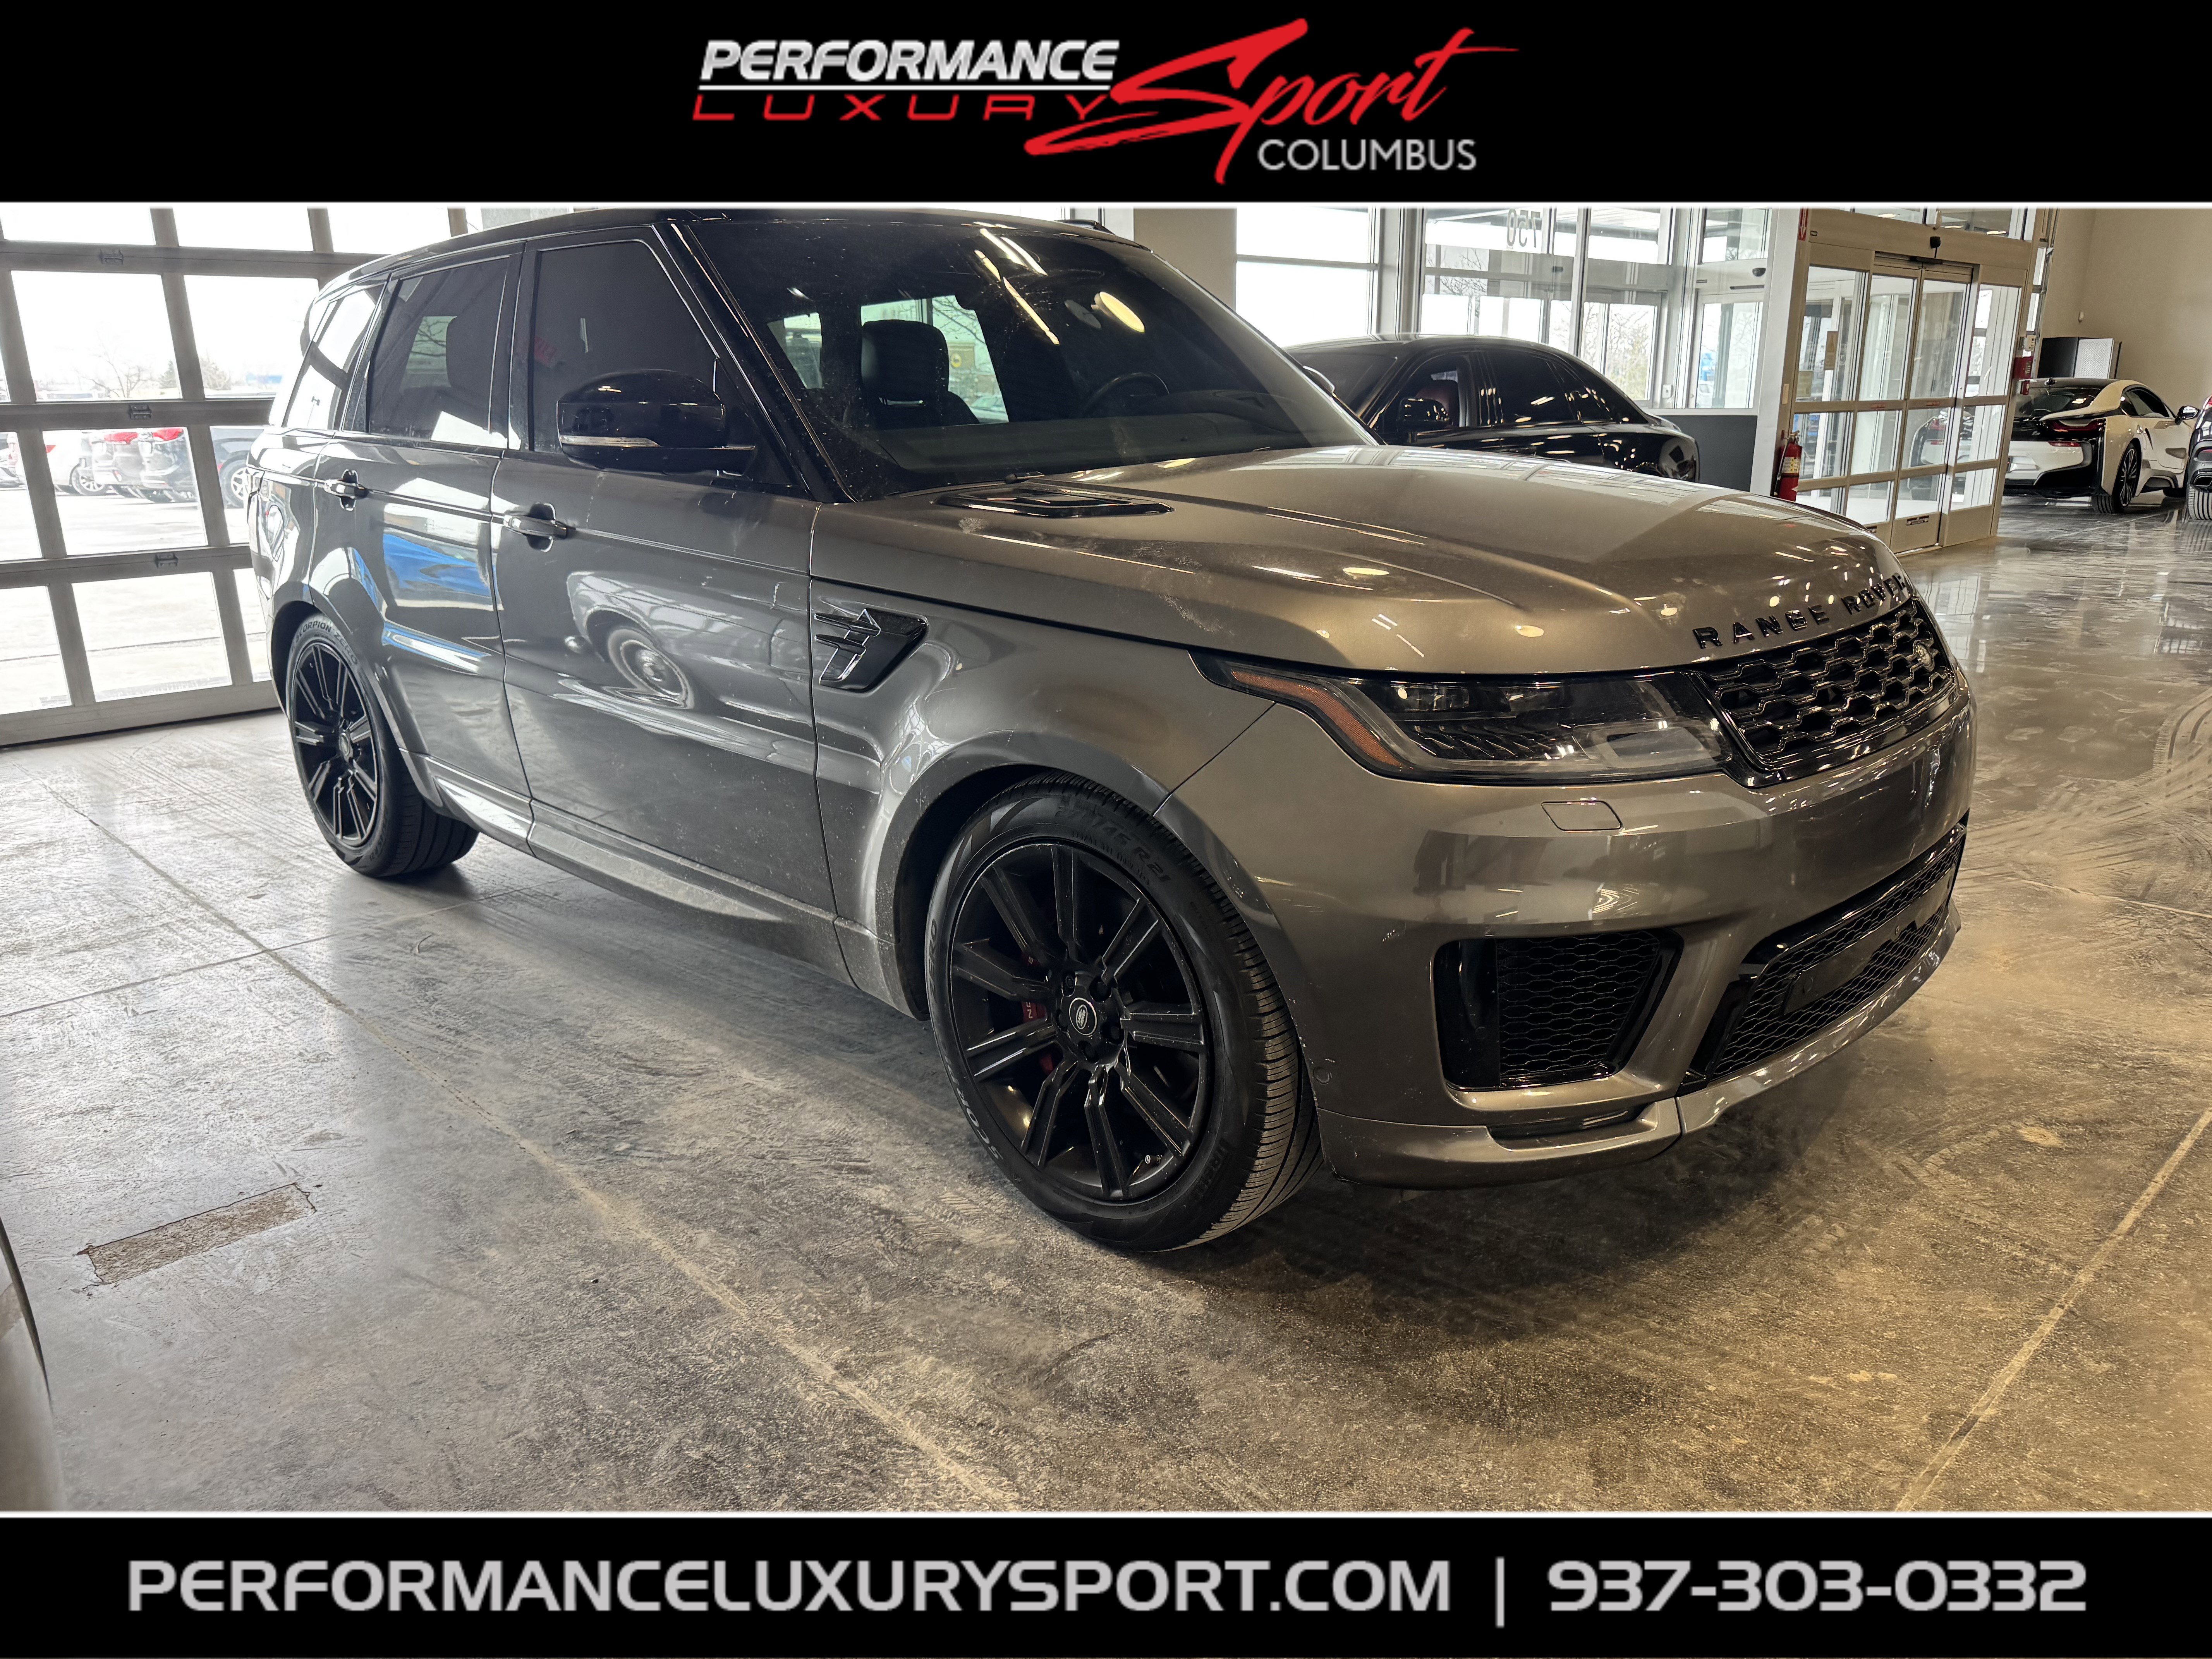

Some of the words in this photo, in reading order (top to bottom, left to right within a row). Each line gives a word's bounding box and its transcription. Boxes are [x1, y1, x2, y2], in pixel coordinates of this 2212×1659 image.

[296, 621, 332, 642] SCORPION
[333, 632, 358, 665] ZERO
[1692, 605, 1830, 649] RANGE
[1841, 572, 1905, 615] ROVER
[929, 918, 938, 1003] ZERO
